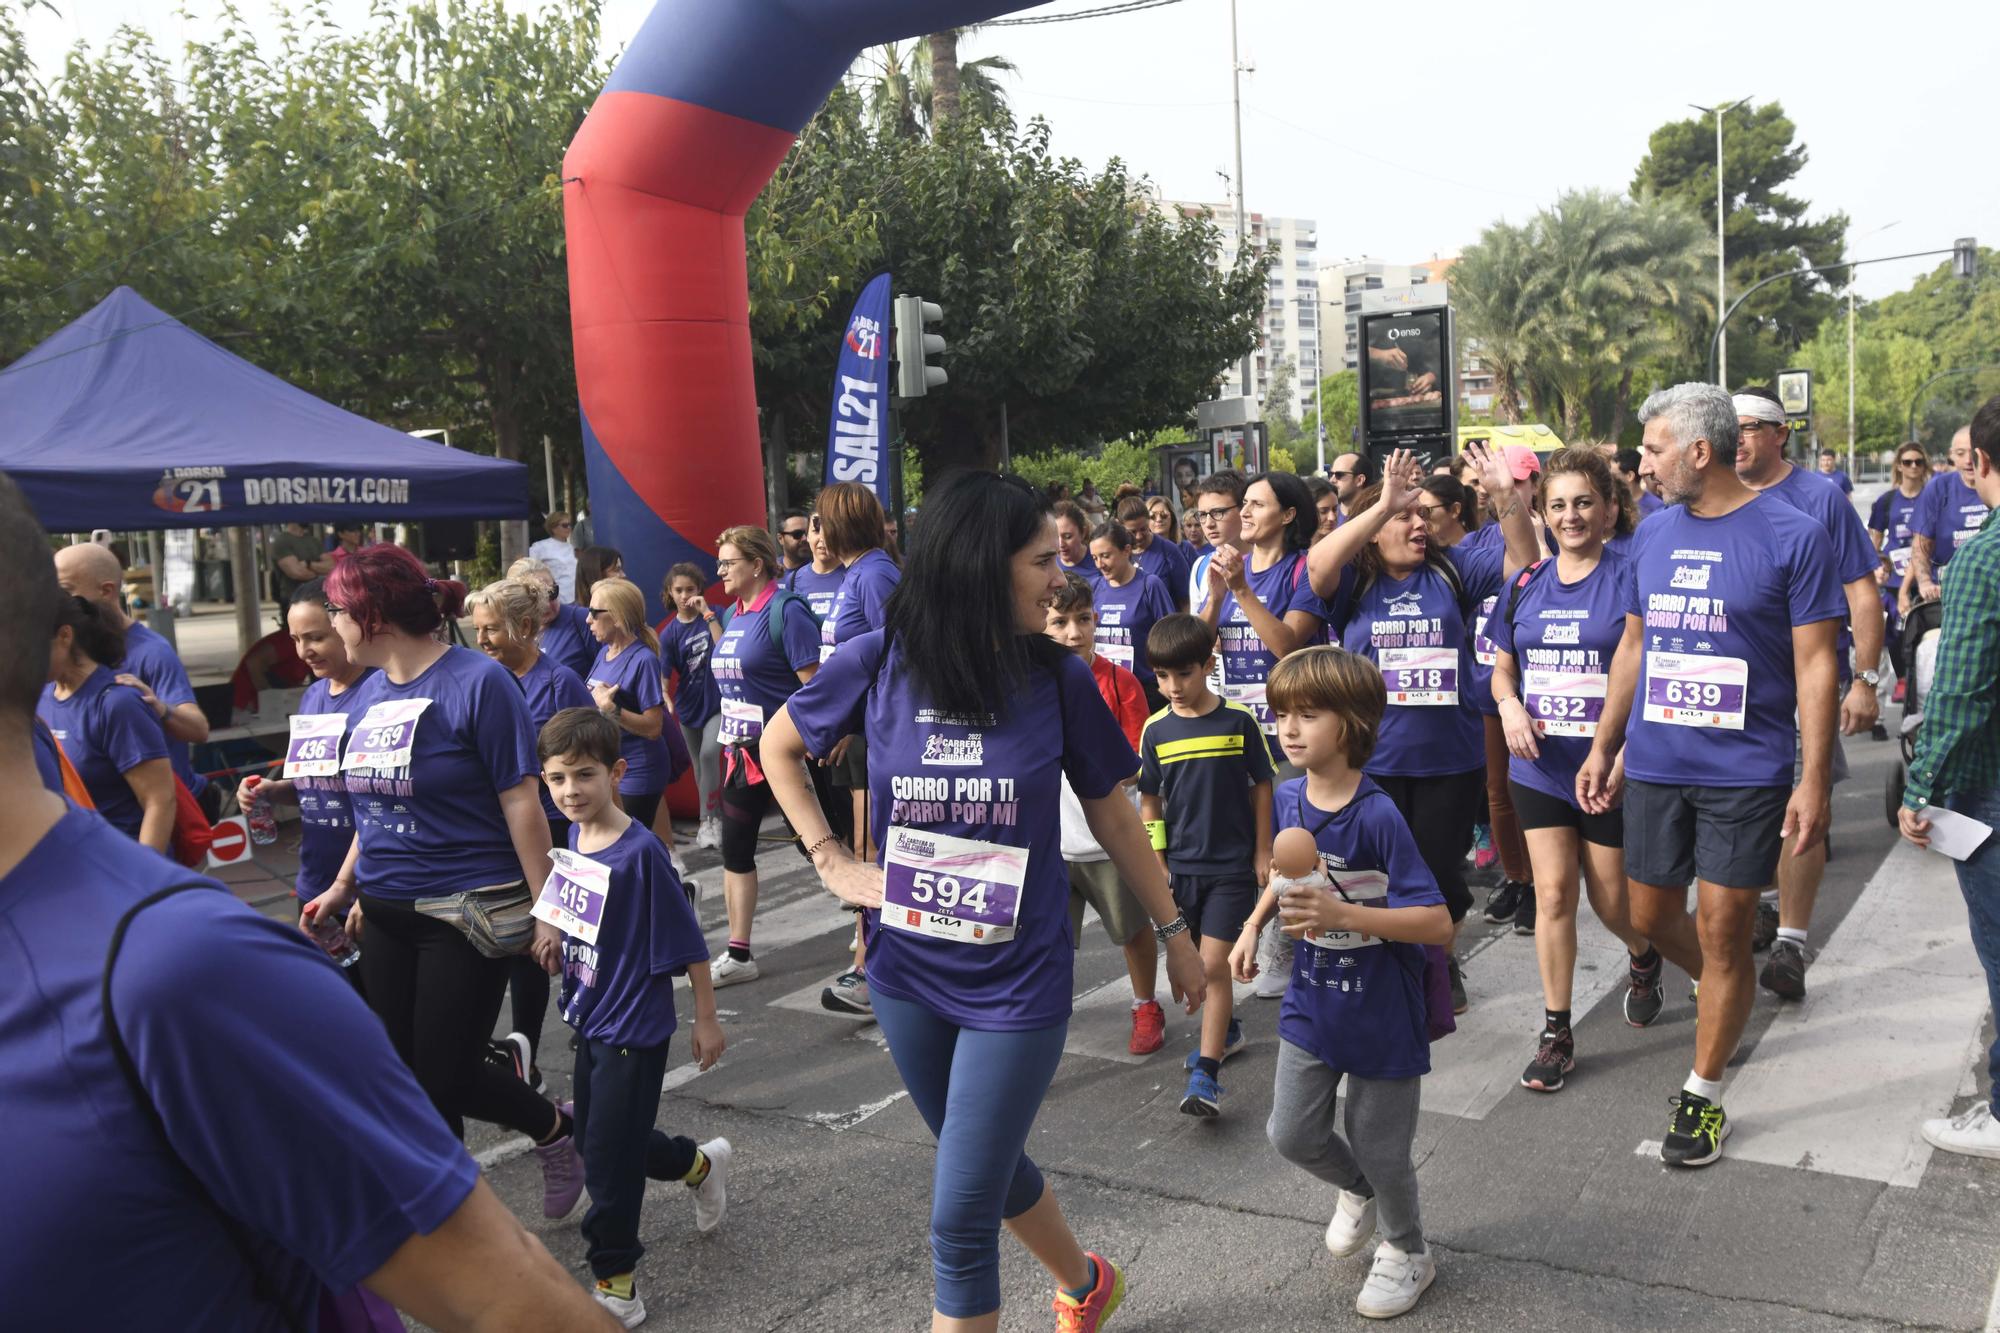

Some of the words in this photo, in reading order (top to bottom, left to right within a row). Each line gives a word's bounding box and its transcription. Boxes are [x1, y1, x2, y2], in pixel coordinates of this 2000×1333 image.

[1400, 328, 1421, 337] enso
[858, 329, 876, 360] 21
[833, 375, 879, 494] SAL21
[174, 466, 226, 478] DORSAL
[181, 480, 221, 513] 21
[244, 478, 409, 505] DORSAL21.COM
[1649, 593, 1686, 613] CORRO
[1688, 597, 1710, 615] POR
[1713, 599, 1724, 616] TI
[1372, 620, 1405, 635] CORRO
[1408, 619, 1429, 633] POR
[1431, 618, 1441, 632] TI
[1646, 611, 1681, 629] CORRO
[1683, 614, 1707, 632] POR
[1243, 640, 1259, 651] POR
[1371, 634, 1403, 648] CORRO
[1406, 633, 1427, 647] POR
[1526, 649, 1560, 665] CORRO
[1563, 650, 1585, 666] POR
[1588, 650, 1599, 666] TI
[1398, 670, 1442, 688] 518
[1666, 680, 1721, 706] 639
[1538, 695, 1586, 718] 632
[363, 724, 405, 748] 569
[724, 718, 748, 736] 511
[297, 739, 327, 760] 436
[943, 739, 982, 748] CARRERA
[953, 747, 965, 755] DE
[967, 747, 983, 756] LAS
[939, 753, 981, 761] CIUDADES
[373, 777, 394, 795] POR
[891, 776, 948, 801] CORRO
[955, 778, 992, 801] POR
[998, 779, 1014, 801] TI
[891, 799, 945, 823] CORRO
[951, 803, 987, 824] POR
[992, 798, 1020, 826] MÍ
[559, 880, 589, 914] 415
[911, 871, 987, 914] 594
[938, 907, 954, 916] ZETA
